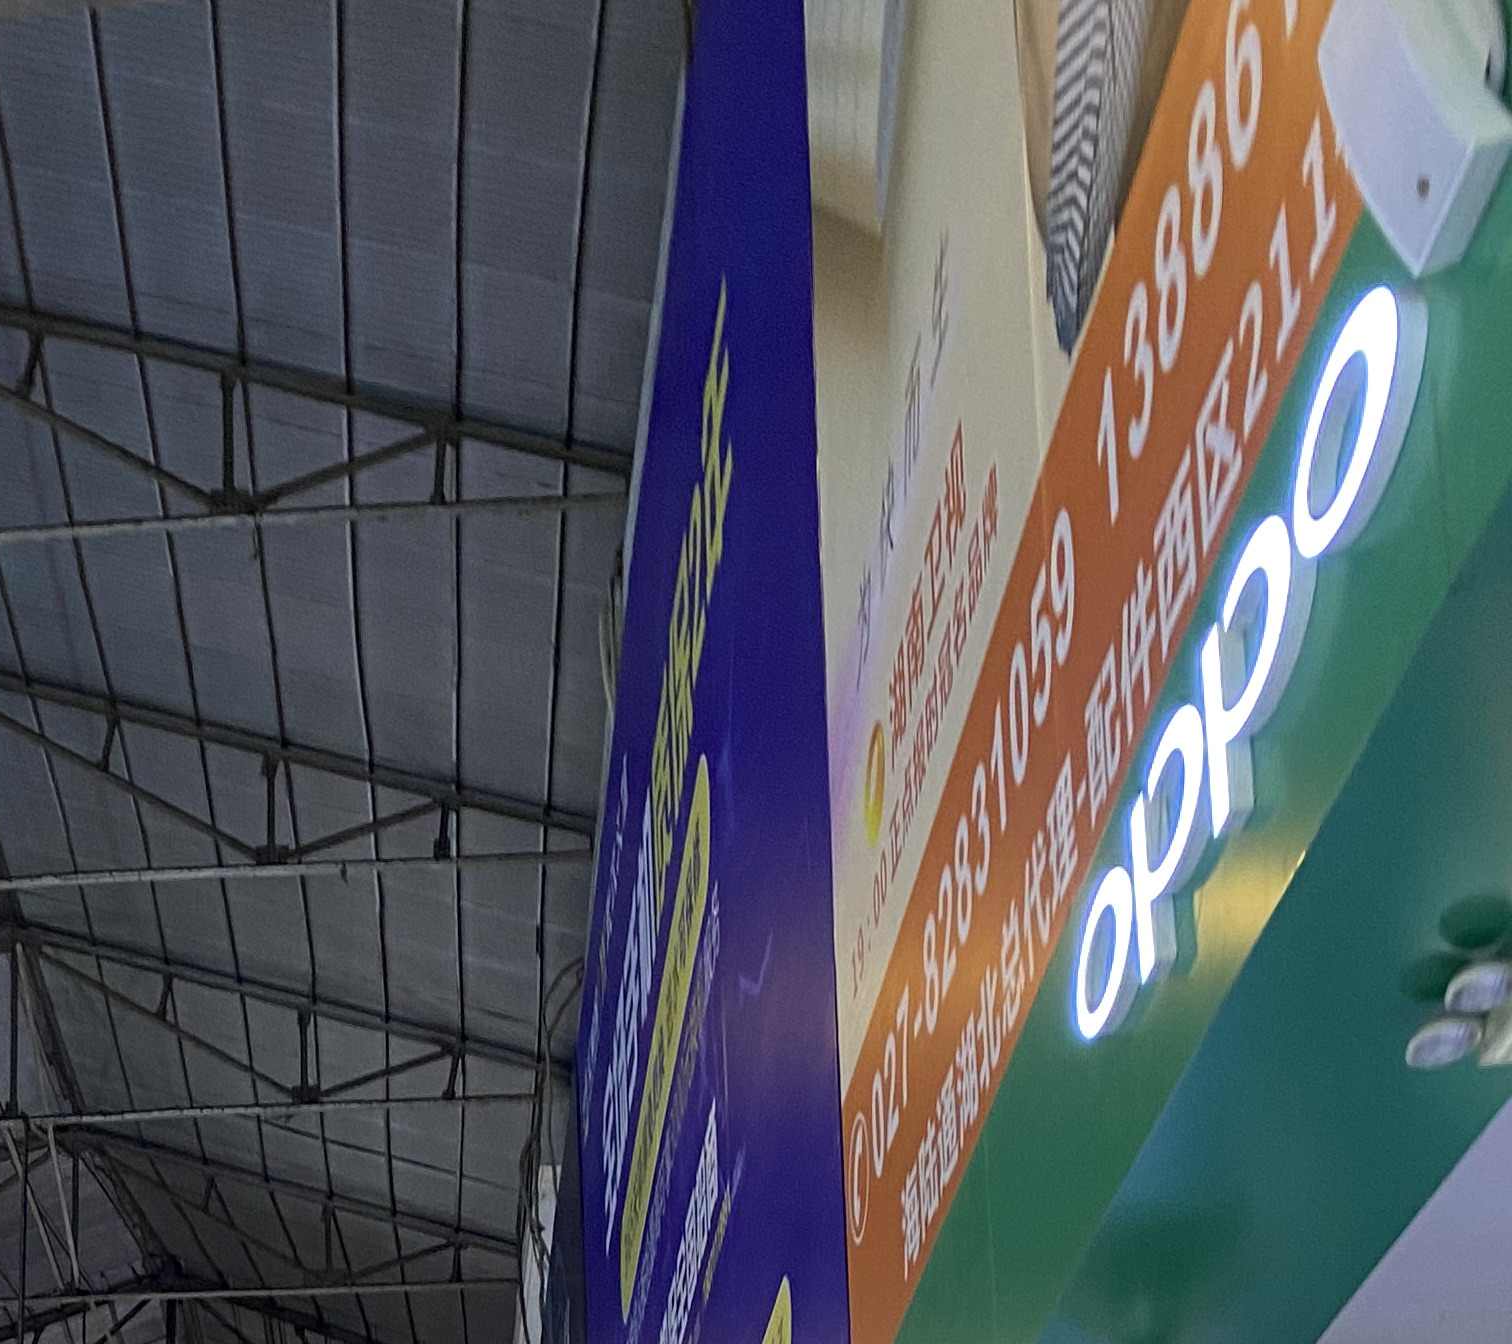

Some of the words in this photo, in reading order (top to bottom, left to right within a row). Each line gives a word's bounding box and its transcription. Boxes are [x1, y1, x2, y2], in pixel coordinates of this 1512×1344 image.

[867, 507, 1077, 1180] 027-82831059
[1097, 0, 1300, 526] 13886
[889, 419, 967, 771] 湖南卫视
[1076, 285, 1403, 1040] oppo
